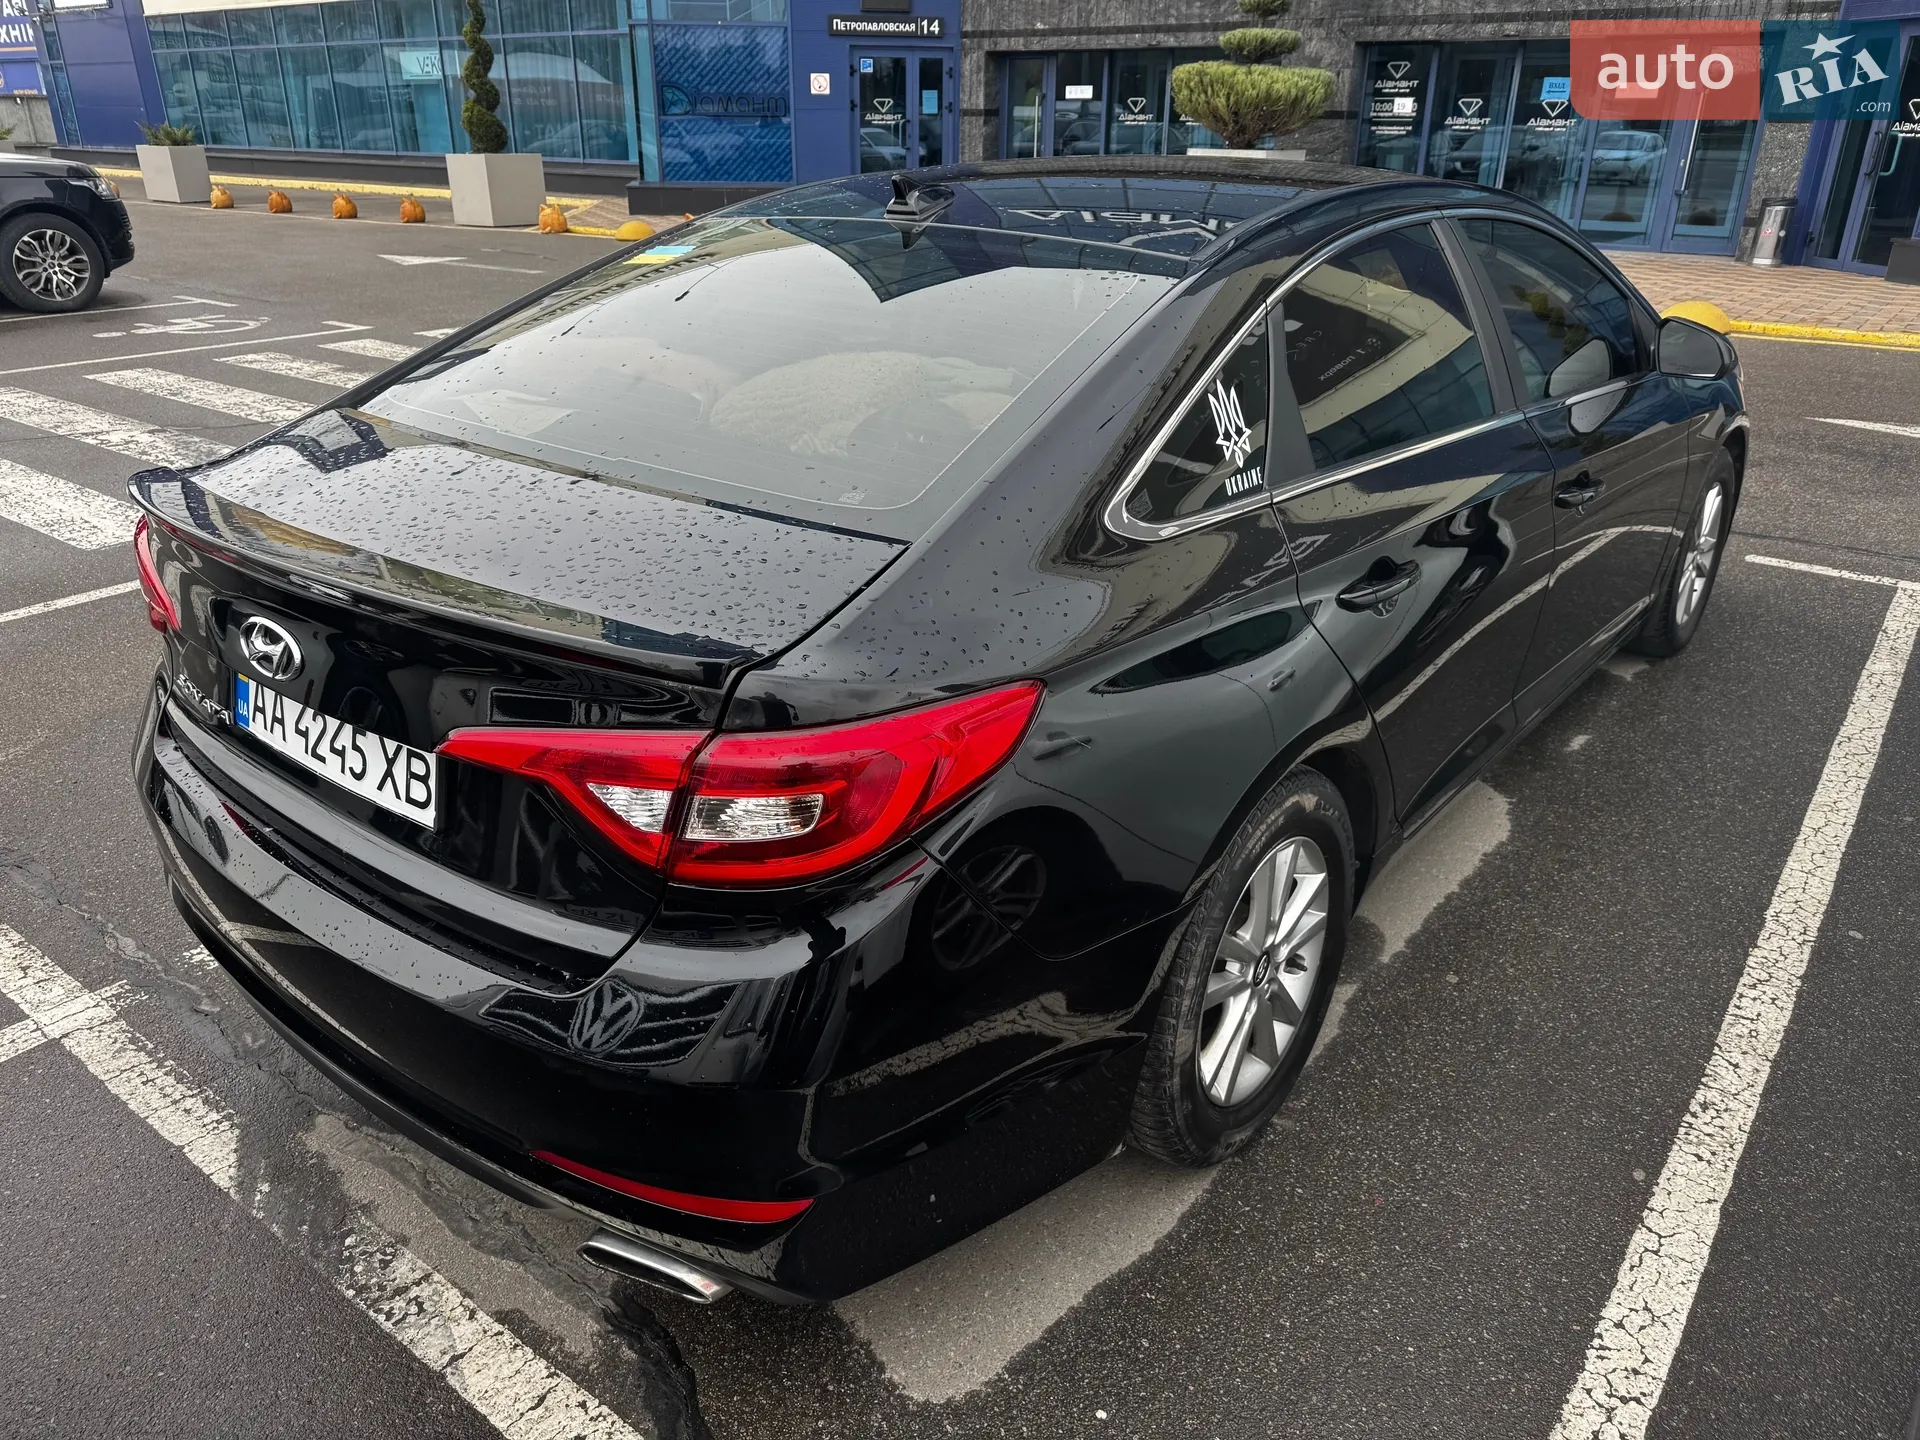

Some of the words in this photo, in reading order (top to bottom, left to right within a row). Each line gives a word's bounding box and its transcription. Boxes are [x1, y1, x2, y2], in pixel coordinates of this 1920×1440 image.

[921, 18, 940, 35] 14
[1224, 466, 1263, 496] UKRAINE
[237, 697, 249, 719] UA
[251, 683, 288, 743] AA
[294, 706, 368, 782] 4245
[375, 735, 433, 810] XB
